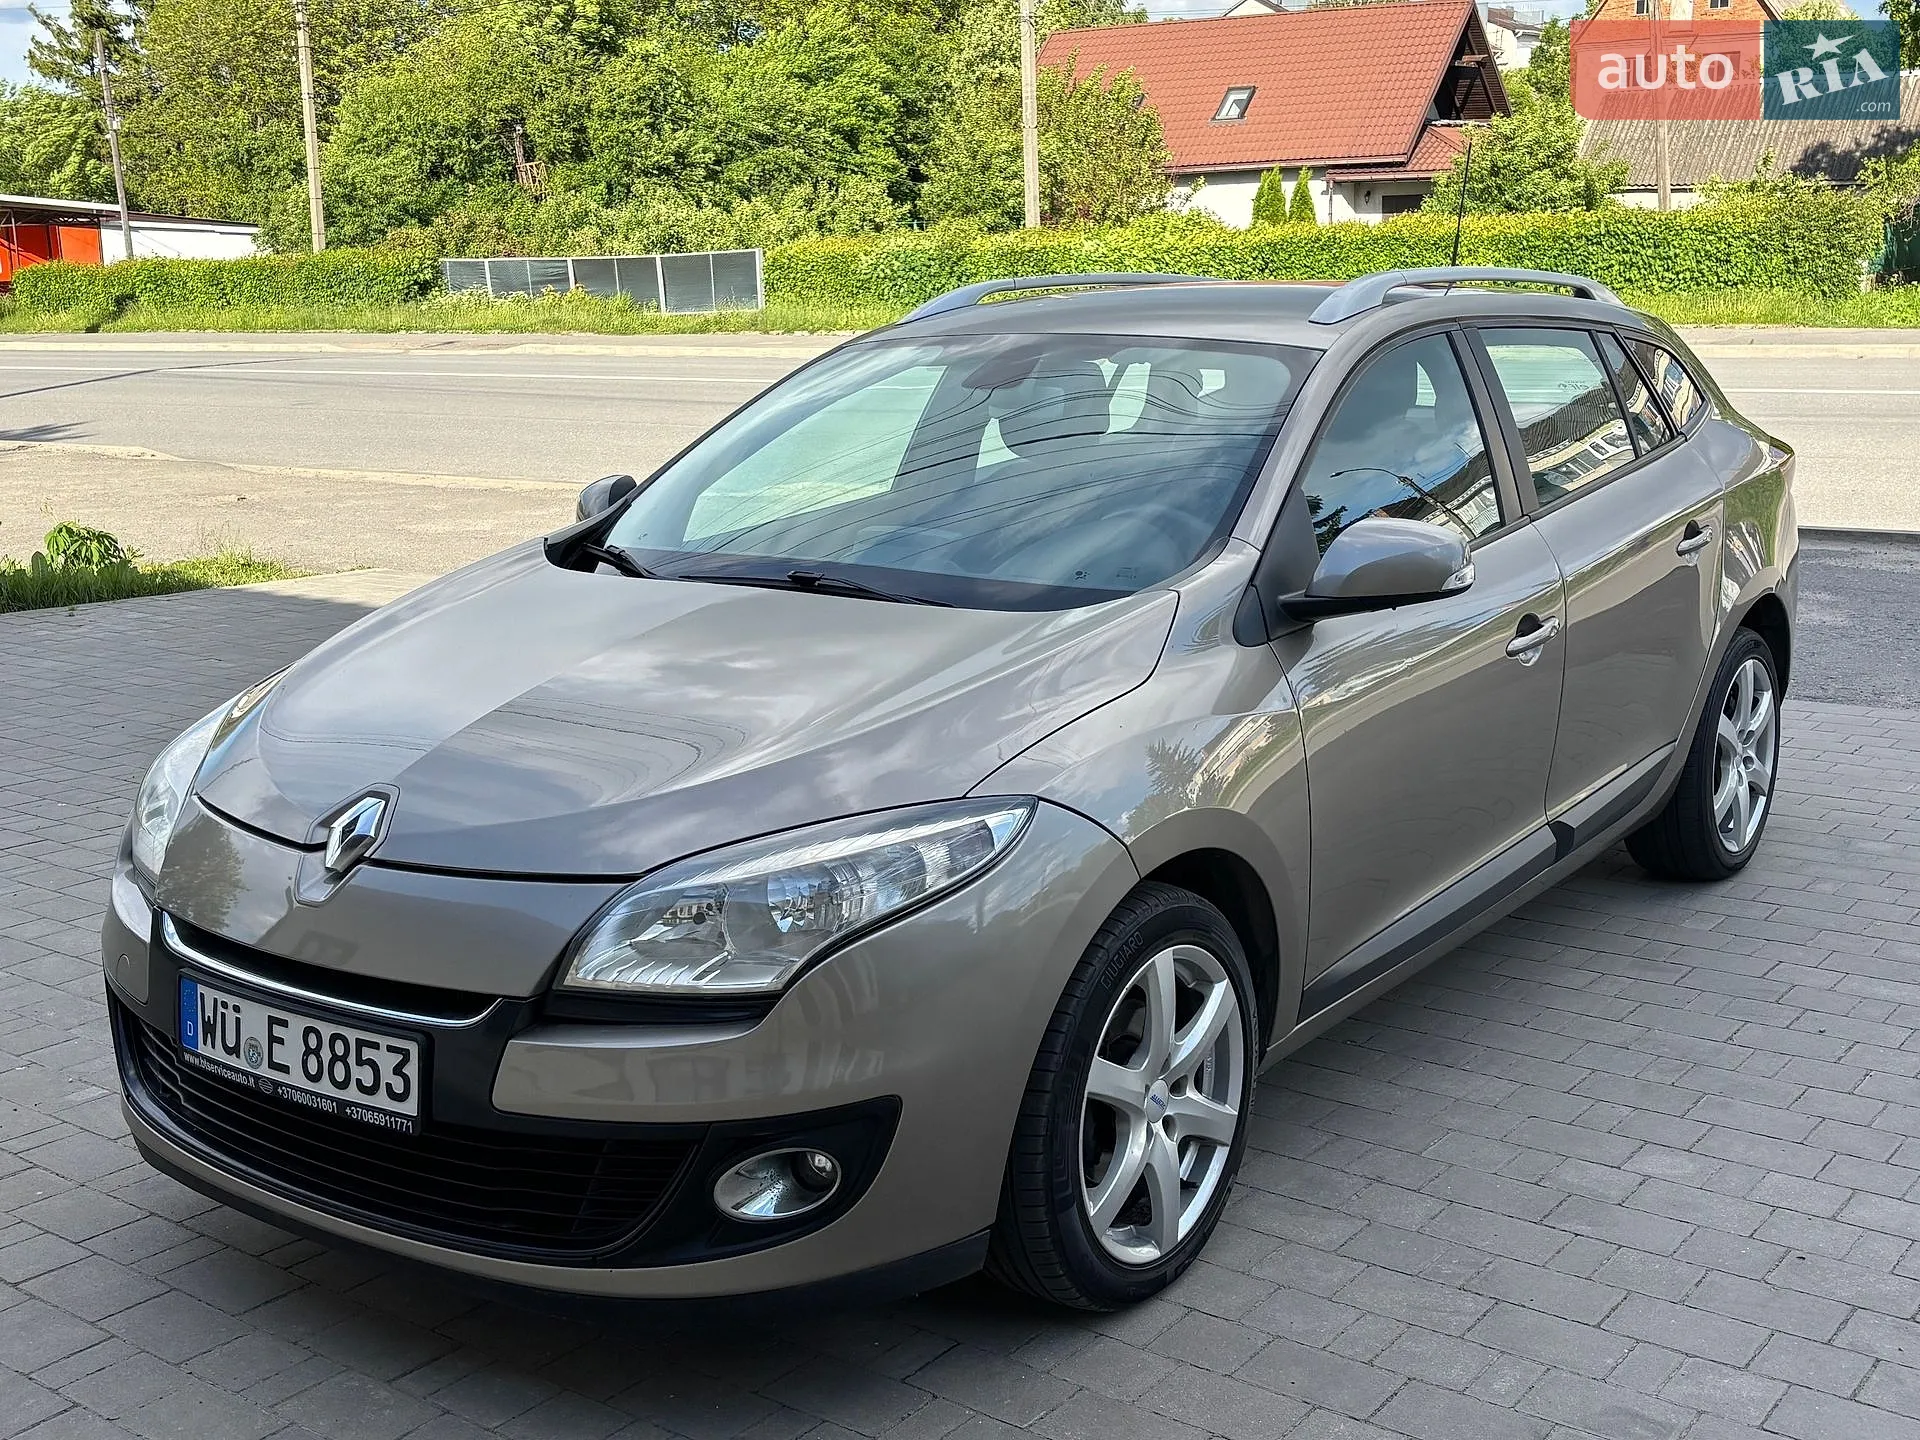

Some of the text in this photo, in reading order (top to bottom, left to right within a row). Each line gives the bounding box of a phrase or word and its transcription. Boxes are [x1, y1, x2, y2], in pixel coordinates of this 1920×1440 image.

[187, 1021, 194, 1036] D
[267, 1014, 291, 1075] E
[301, 1025, 411, 1103] 8853
[277, 1086, 338, 1114] +37060031601
[345, 1106, 413, 1134] +37065911771
